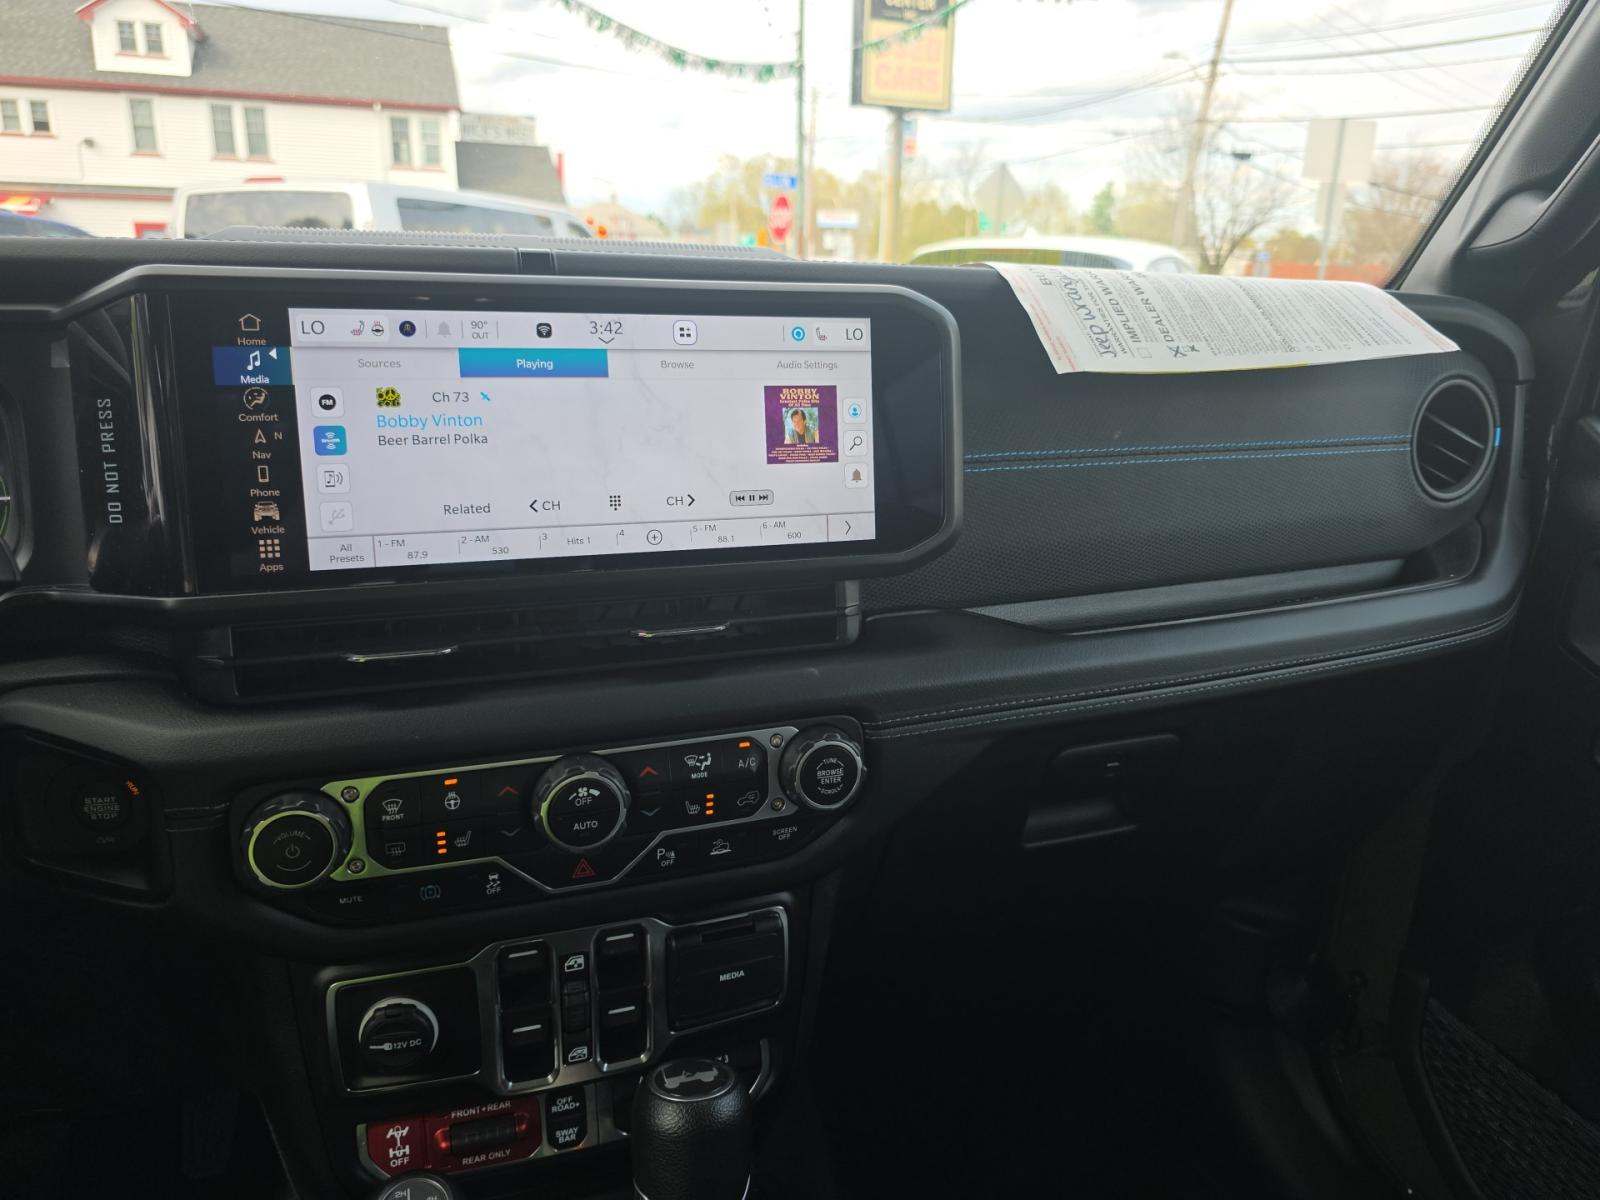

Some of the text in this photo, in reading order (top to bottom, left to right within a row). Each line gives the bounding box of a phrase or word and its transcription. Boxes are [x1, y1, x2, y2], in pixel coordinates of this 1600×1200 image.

[1108, 298, 1142, 342] IMPLIED
[1140, 297, 1174, 342] DEALER
[300, 320, 325, 335] LO
[589, 321, 624, 335] 3:42
[471, 332, 489, 340] OUT
[845, 328, 863, 341] LO
[237, 336, 266, 346] Home
[358, 358, 402, 369] Sources
[516, 358, 554, 370] Playing
[660, 360, 694, 370] Browse
[776, 360, 838, 372] Audio Settings
[240, 374, 270, 384] Media
[432, 391, 470, 403] Ch 73
[238, 413, 278, 422] Comfort
[376, 414, 483, 430] Bobby Vinton
[274, 432, 282, 440] N
[378, 434, 488, 447] Beer Barrel Polka
[252, 451, 271, 460] Nav
[98, 398, 122, 524] DO NOT PRESS
[250, 488, 280, 497] Phone
[542, 500, 561, 511] CH
[666, 496, 684, 506] CH
[443, 503, 491, 515] Related
[251, 525, 285, 534] Vehicle
[705, 524, 717, 532] FM
[391, 539, 406, 547] FM
[476, 535, 490, 543] AM
[567, 537, 584, 545] Hits
[717, 535, 735, 543] 88.1
[340, 544, 352, 552] All
[329, 553, 365, 564] Presets
[407, 551, 428, 559] 87.9
[260, 562, 284, 573] Apps
[738, 756, 756, 768] A/C
[691, 771, 708, 779] MODE
[817, 767, 844, 778] BROWSE
[820, 775, 842, 785] ENTER
[574, 796, 593, 807] OFF
[382, 813, 404, 822] FRONT
[573, 820, 598, 830] AUTO
[279, 830, 305, 841] VOLUME
[772, 826, 798, 837] SCREEN
[778, 832, 791, 840] OFF
[661, 858, 676, 867] OFF
[486, 886, 501, 895] OFF
[339, 896, 363, 905] MUTE
[719, 970, 745, 982] MEDIA
[393, 1038, 422, 1050] 12V DC
[556, 1096, 573, 1106] OFF
[552, 1102, 580, 1113] ROAD+
[555, 1126, 579, 1138] SWAY
[558, 1134, 576, 1144] BAR
[390, 1157, 410, 1167] OFF
[462, 1149, 512, 1166] REAR ONLY
